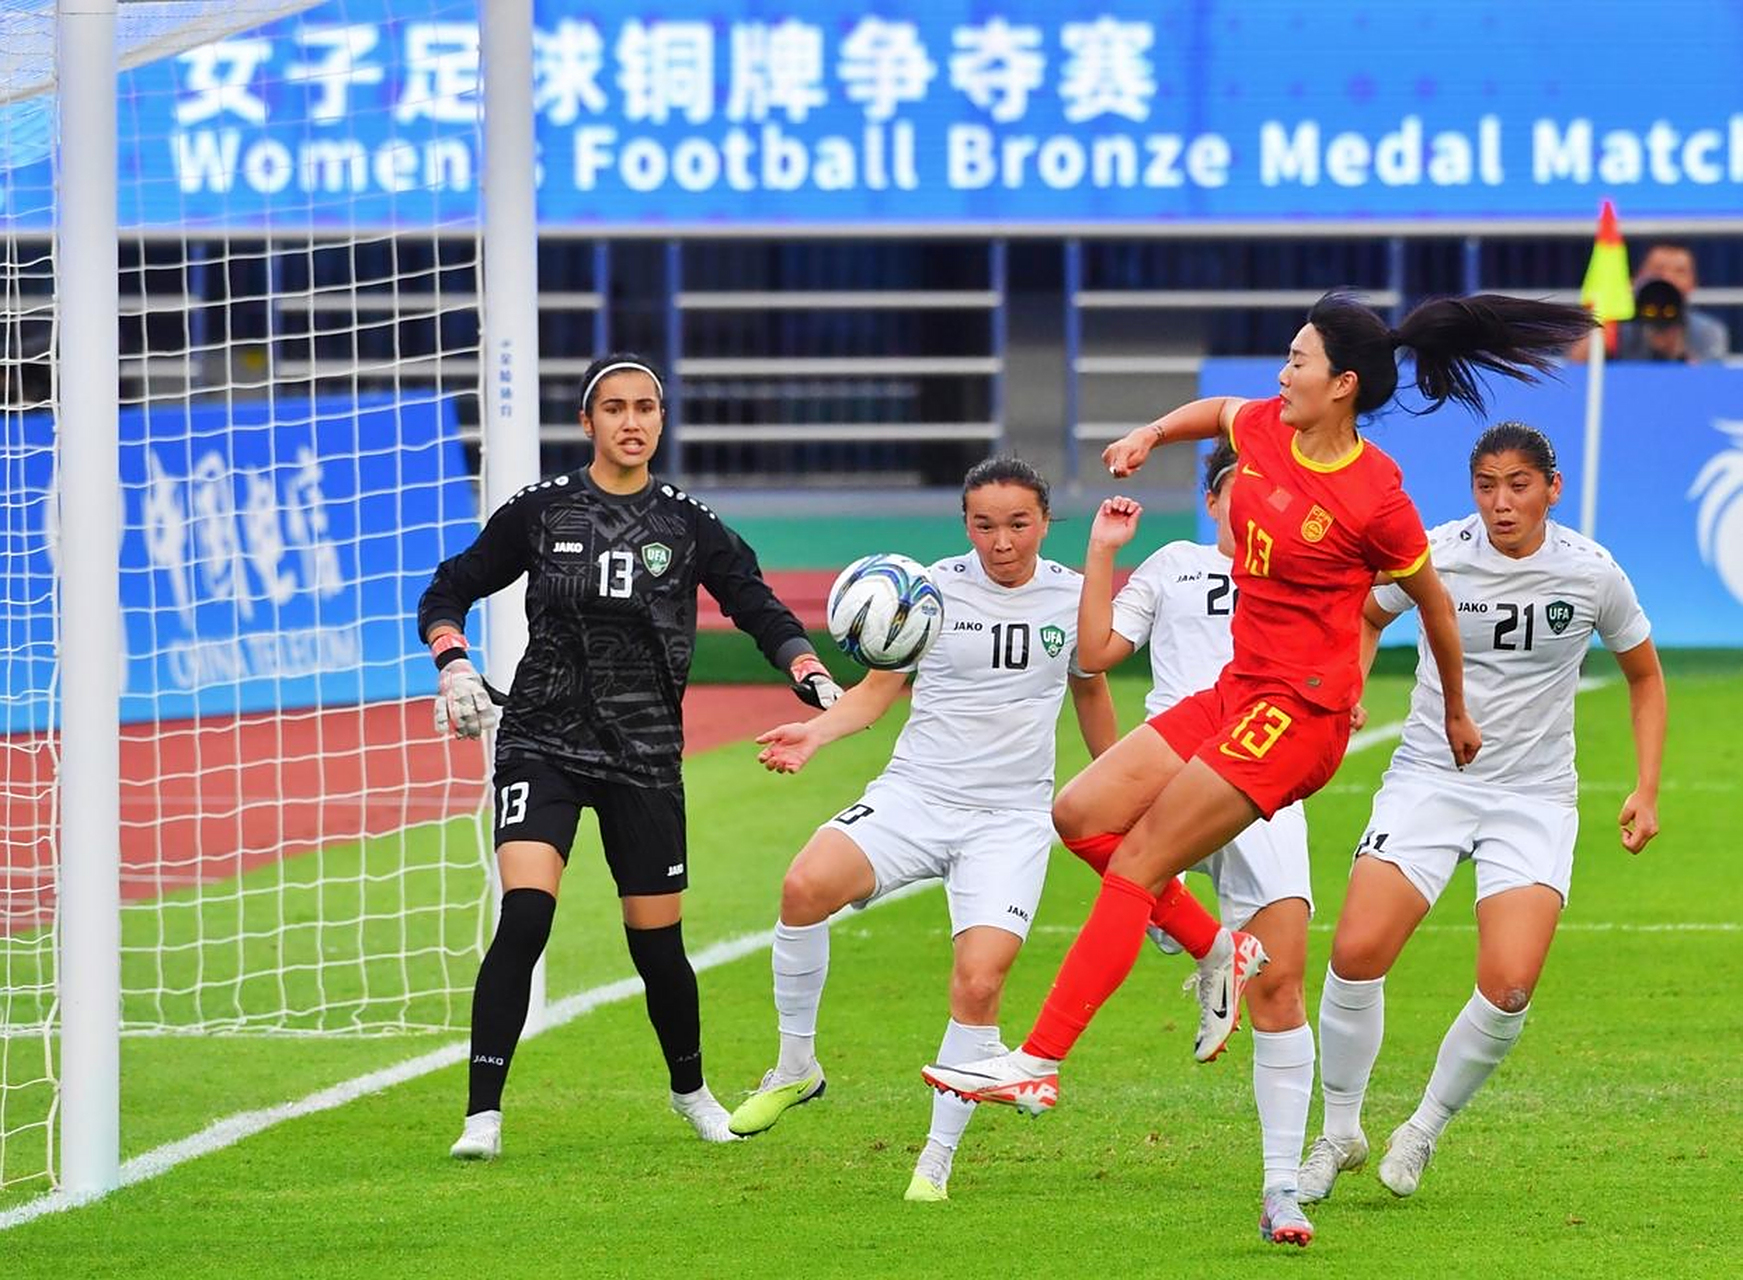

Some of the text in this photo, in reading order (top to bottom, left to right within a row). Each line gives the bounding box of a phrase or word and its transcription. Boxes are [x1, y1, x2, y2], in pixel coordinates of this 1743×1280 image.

[172, 17, 1157, 124] 女子足球铜牌争夺赛
[574, 120, 919, 192] Football
[947, 122, 1230, 190] Bronze
[1260, 114, 1504, 188] Medal
[552, 542, 584, 553] JAKO
[647, 548, 667, 562] UFA
[1245, 519, 1273, 577] 13
[598, 550, 634, 598] 13
[1176, 571, 1202, 583] JAKO
[1207, 573, 1239, 616] 2
[953, 621, 983, 632] JAKO
[1458, 602, 1488, 613] JAKO
[1493, 603, 1534, 651] 21
[1549, 607, 1570, 620] UFA
[991, 623, 1030, 670] 10
[1042, 630, 1063, 645] UFA
[1231, 701, 1292, 758] 13
[500, 781, 529, 828] 13
[473, 1055, 503, 1066] JAKO
